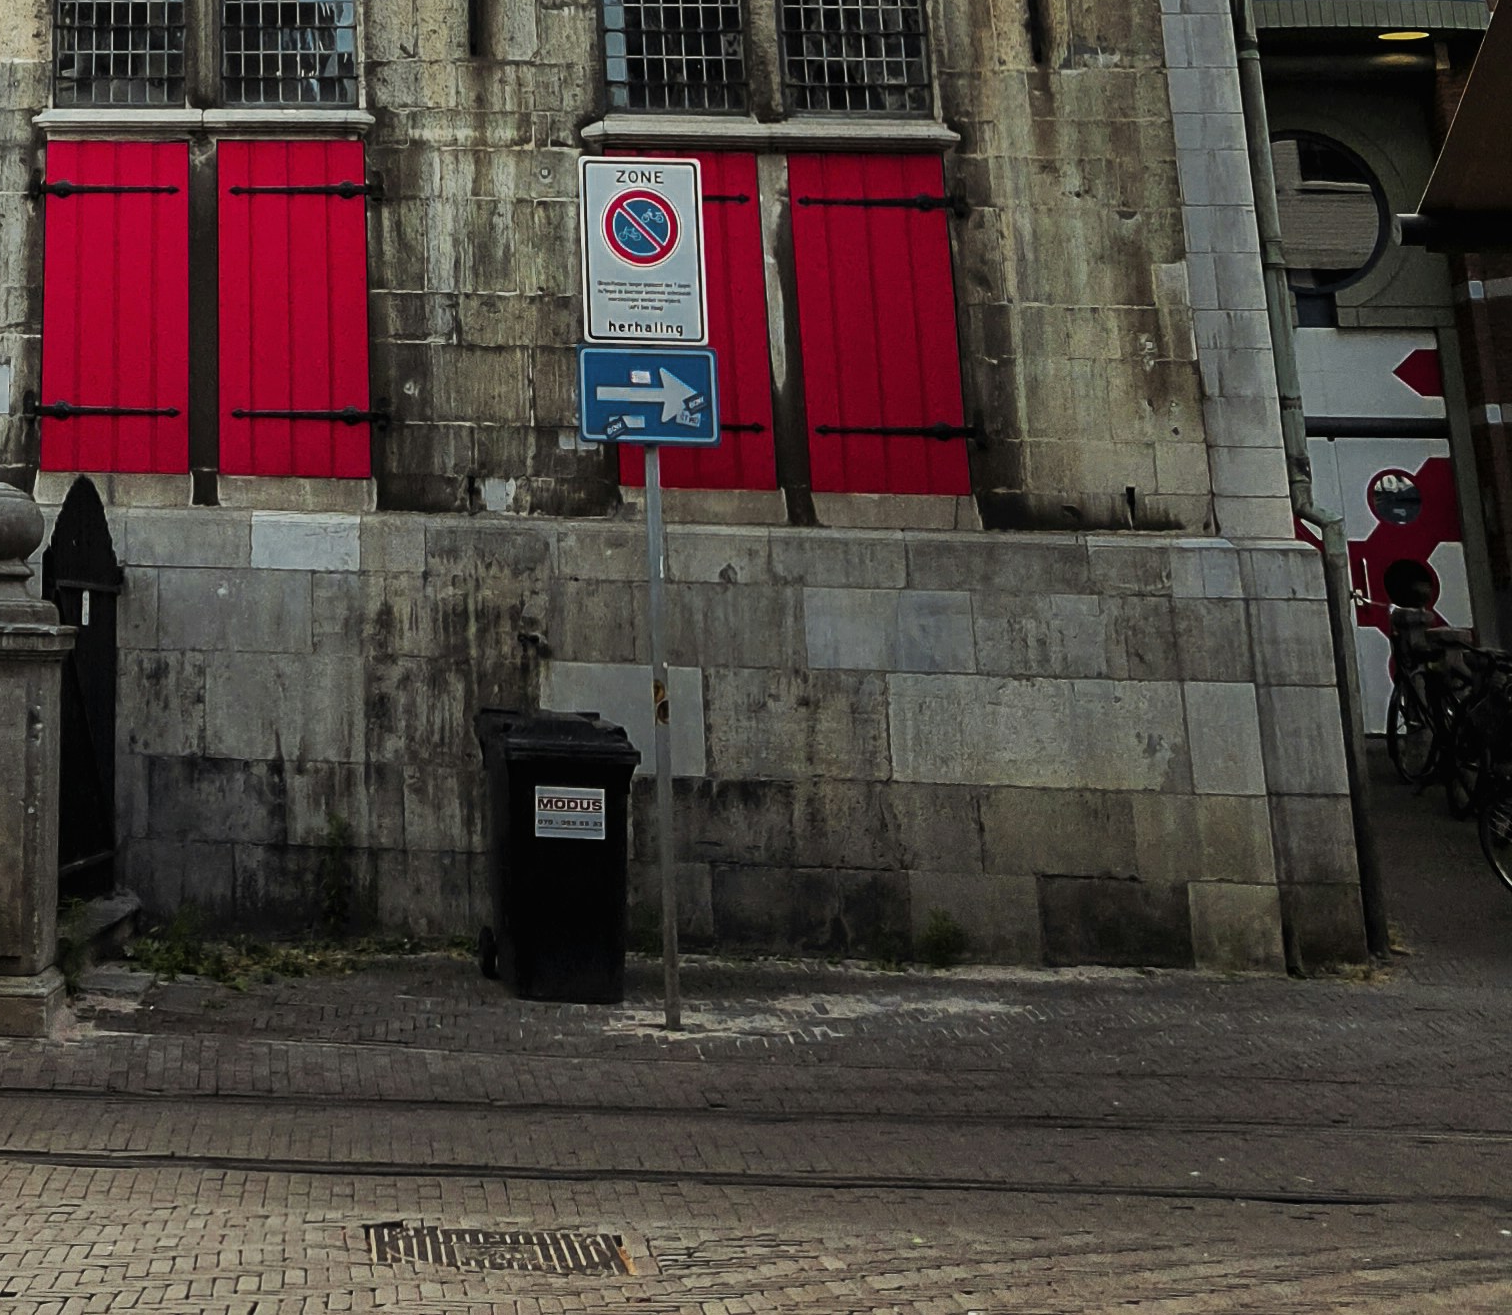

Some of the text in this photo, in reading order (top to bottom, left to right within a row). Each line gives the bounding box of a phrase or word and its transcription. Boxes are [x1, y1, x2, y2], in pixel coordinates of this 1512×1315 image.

[615, 170, 665, 184] ZONE
[608, 320, 683, 337] herhaling
[538, 799, 602, 811] MODUS
